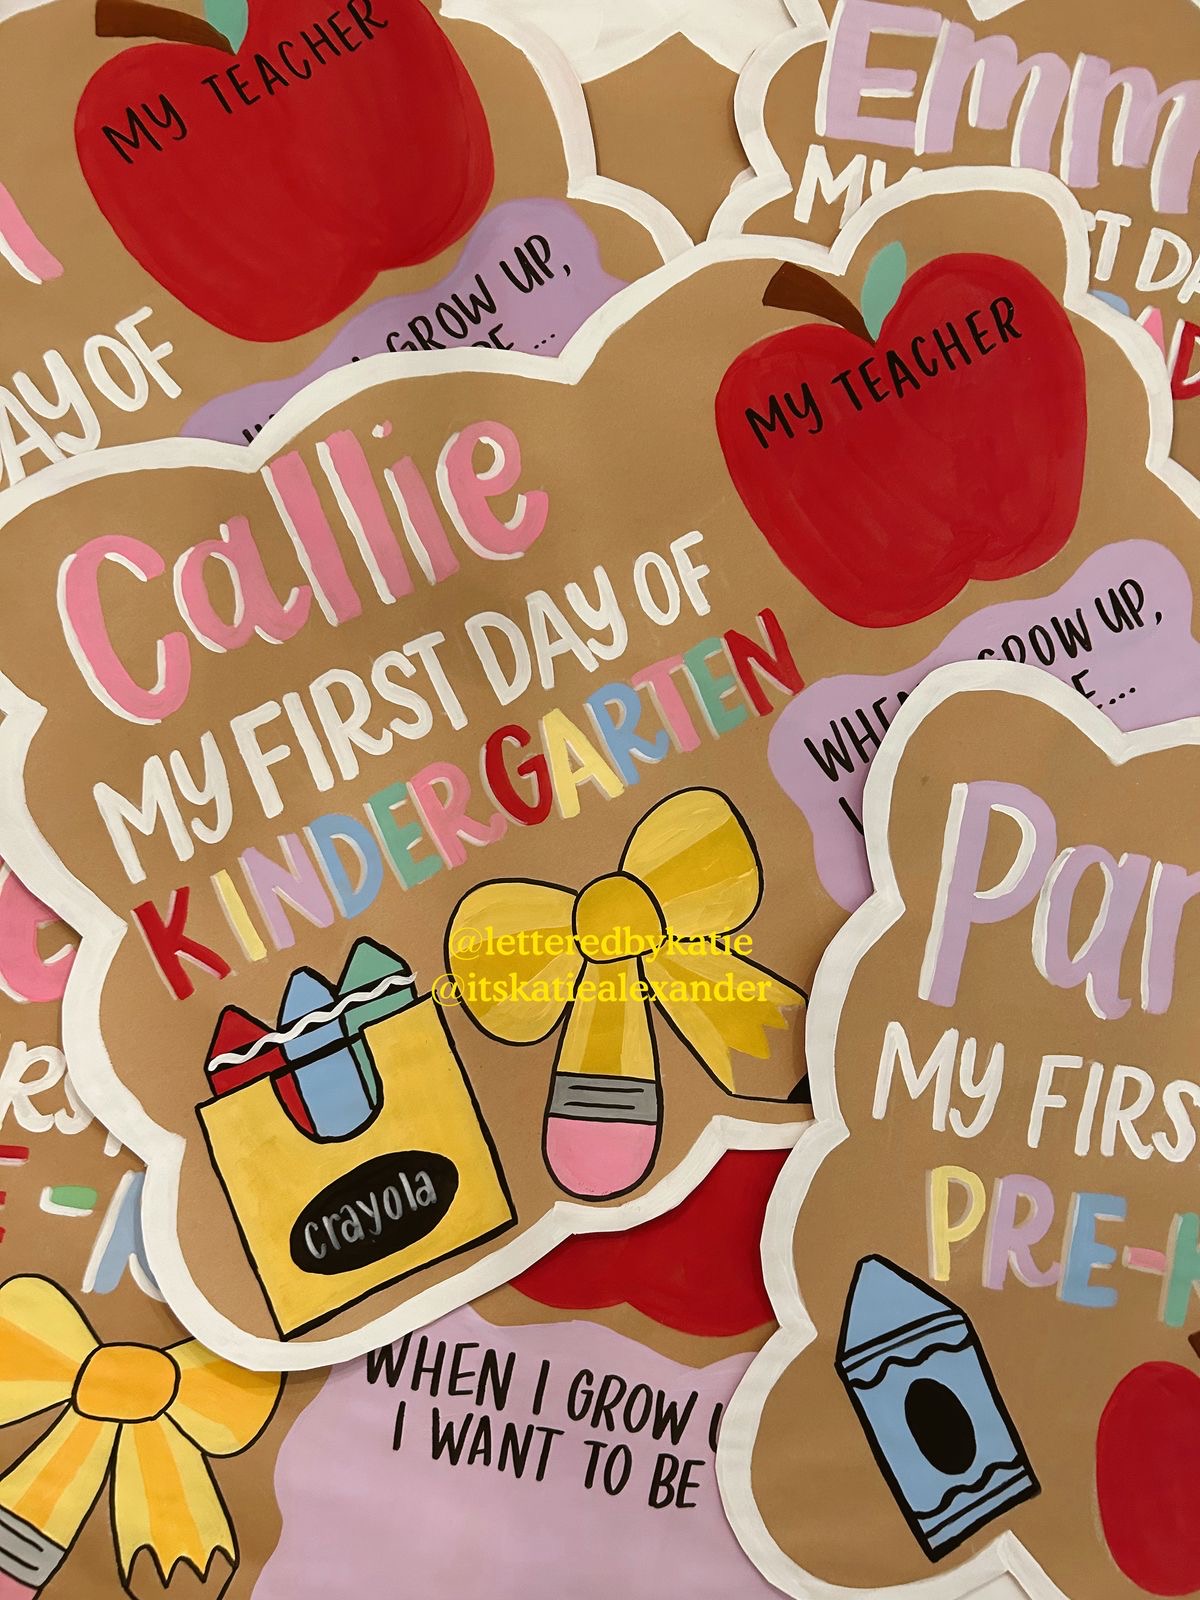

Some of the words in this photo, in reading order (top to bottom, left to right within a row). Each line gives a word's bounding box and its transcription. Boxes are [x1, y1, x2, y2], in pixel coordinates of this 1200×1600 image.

[102, 93, 188, 164] MY
[201, 0, 389, 114] TEACHER
[499, 234, 571, 294] UP,
[0, 385, 101, 487] AY
[83, 306, 183, 412] OF
[744, 382, 824, 449] MY
[831, 296, 1022, 412] TEACHER
[57, 419, 549, 725] Callie
[93, 731, 233, 884] MY
[230, 631, 468, 818] FIRST
[465, 565, 628, 705] DAY
[633, 530, 711, 627] OF
[803, 680, 920, 773] WH
[977, 608, 1093, 666] OW
[1094, 579, 1162, 634] UP,
[131, 607, 806, 1000] KINDERGARTEN
[873, 1021, 1005, 1139] MY
[303, 1169, 438, 1260] crayola
[366, 1331, 516, 1412] WHEN
[532, 1360, 550, 1416] I
[567, 1368, 699, 1446] GROW
[392, 1400, 406, 1452] I
[432, 1406, 565, 1483] WANT
[583, 1440, 633, 1496] TO
[648, 1453, 706, 1509] BE
